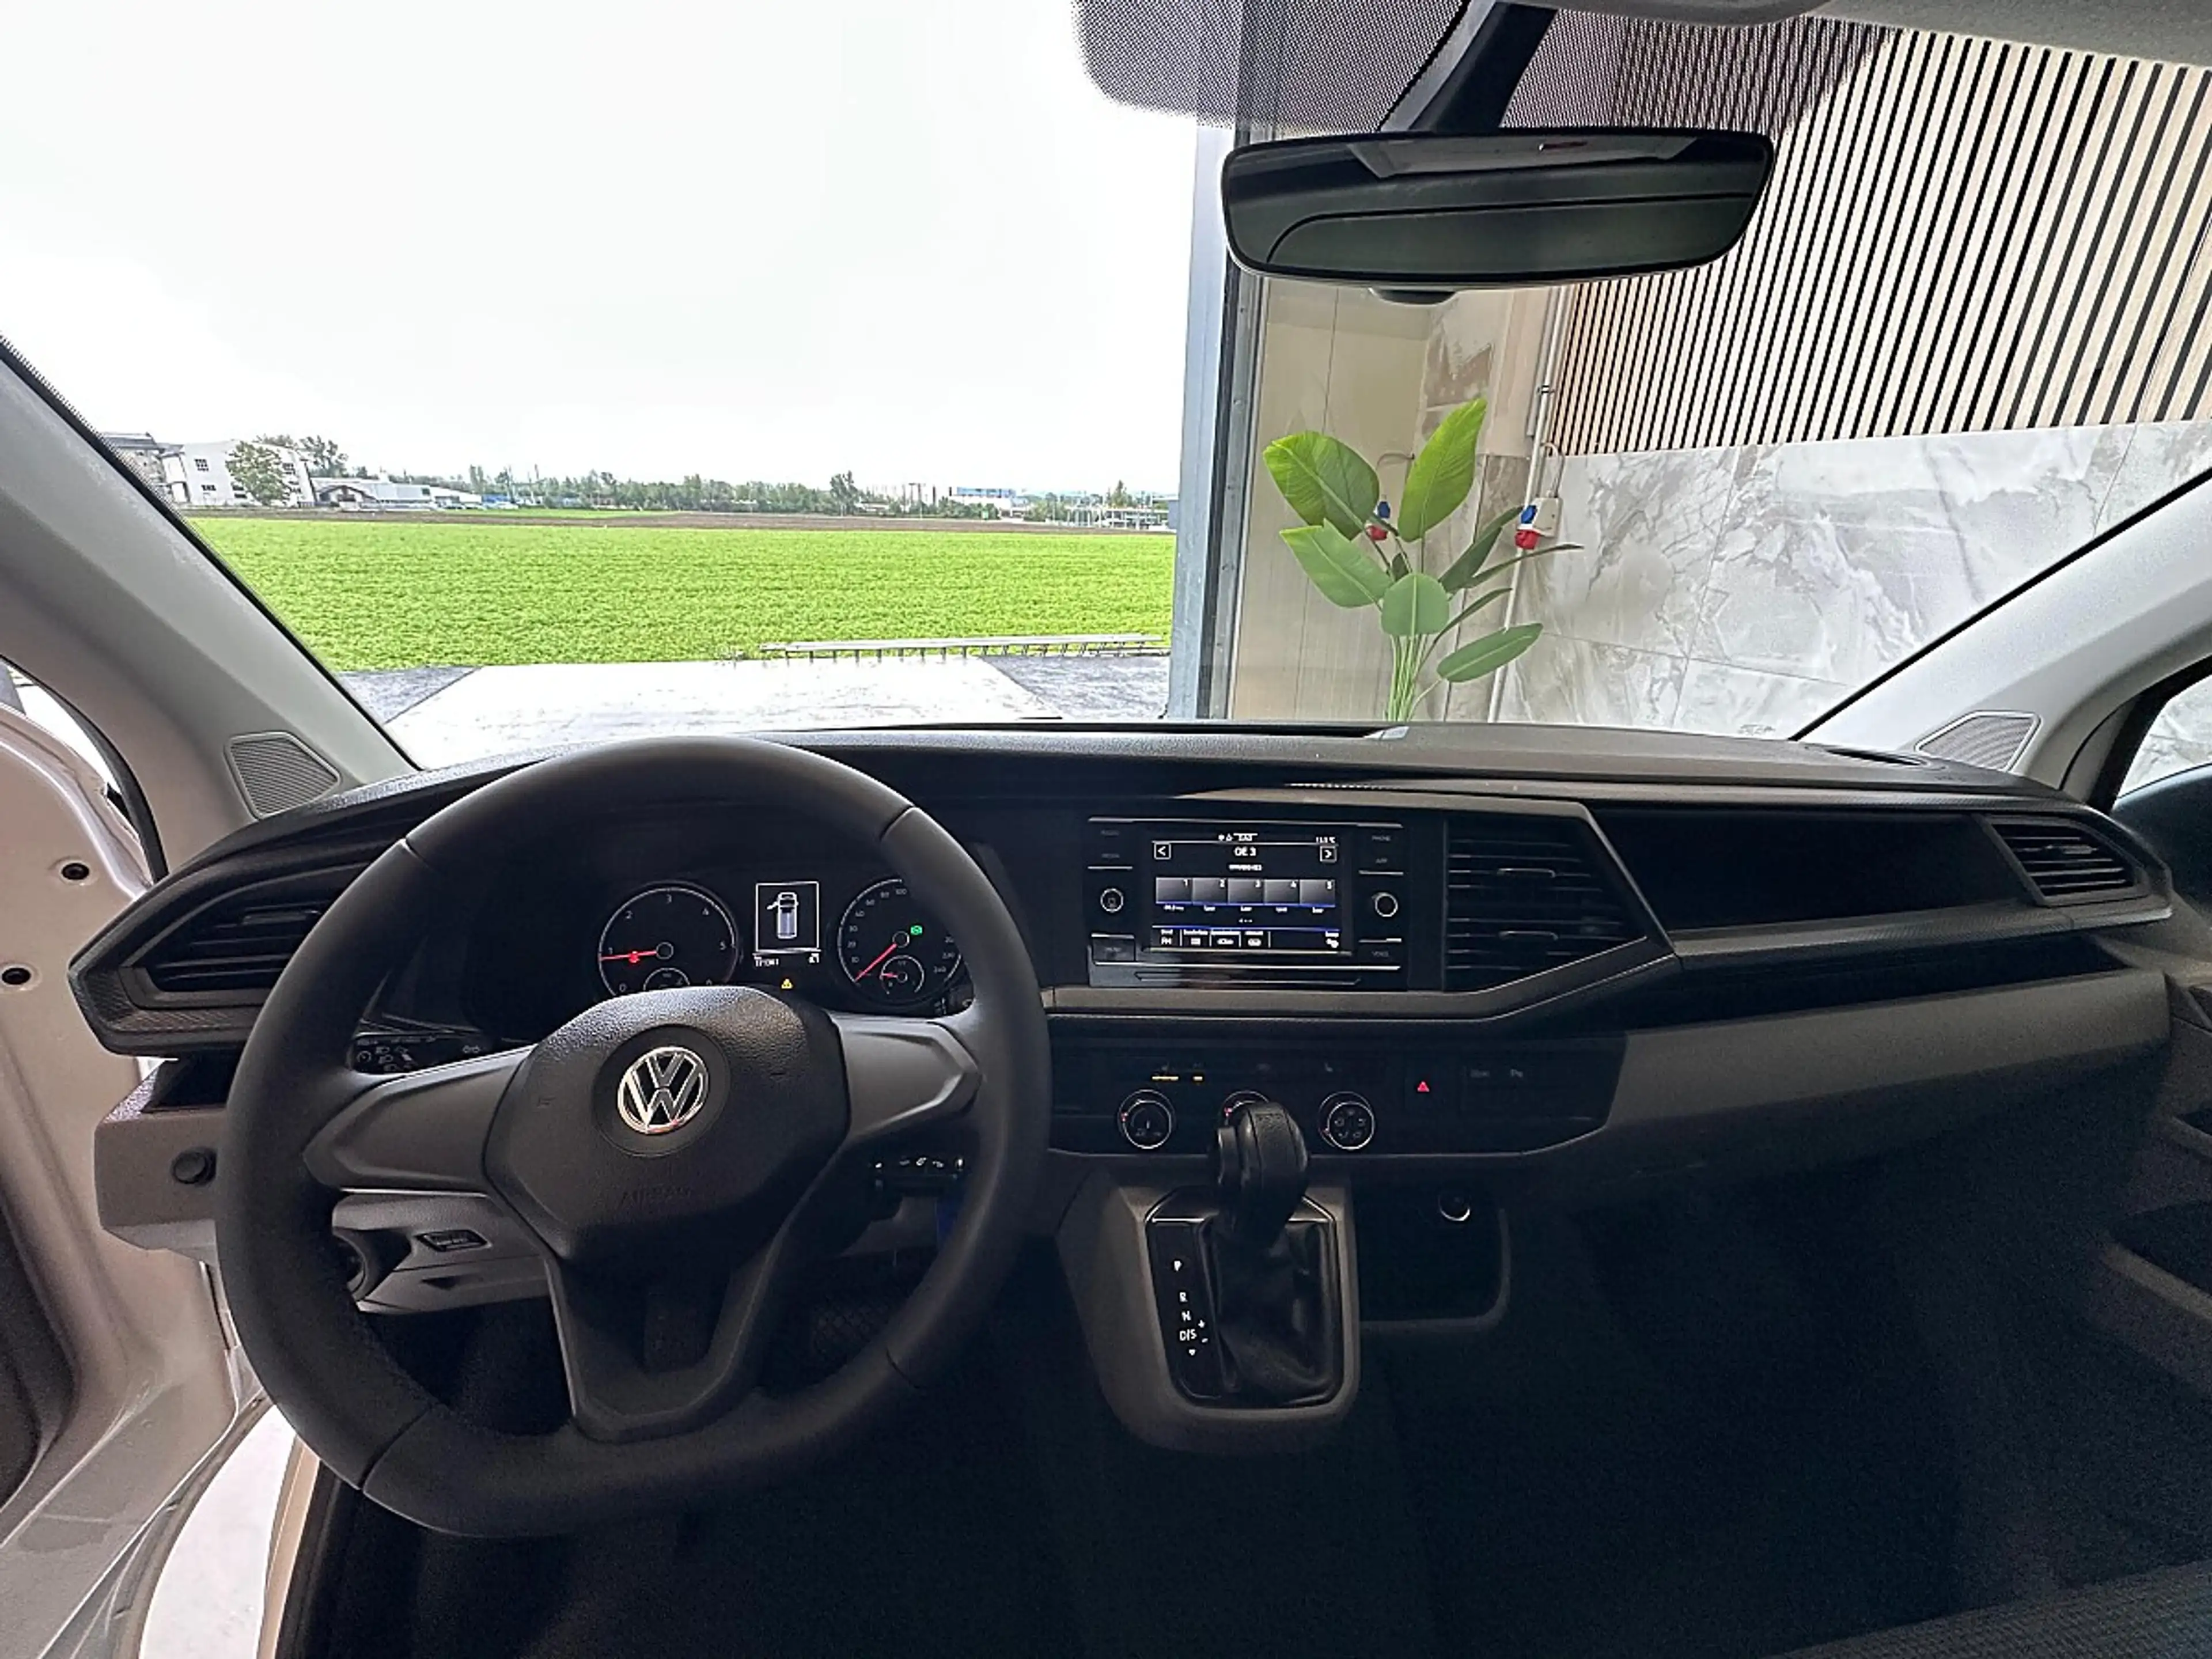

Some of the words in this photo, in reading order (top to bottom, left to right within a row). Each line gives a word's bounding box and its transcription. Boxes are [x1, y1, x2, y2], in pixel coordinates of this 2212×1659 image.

[665, 895, 672, 903] 3
[626, 911, 632, 919] 2
[719, 942, 726, 950] 5
[1173, 1260, 1182, 1271] P
[1179, 1292, 1188, 1302] R
[1181, 1310, 1191, 1321] N
